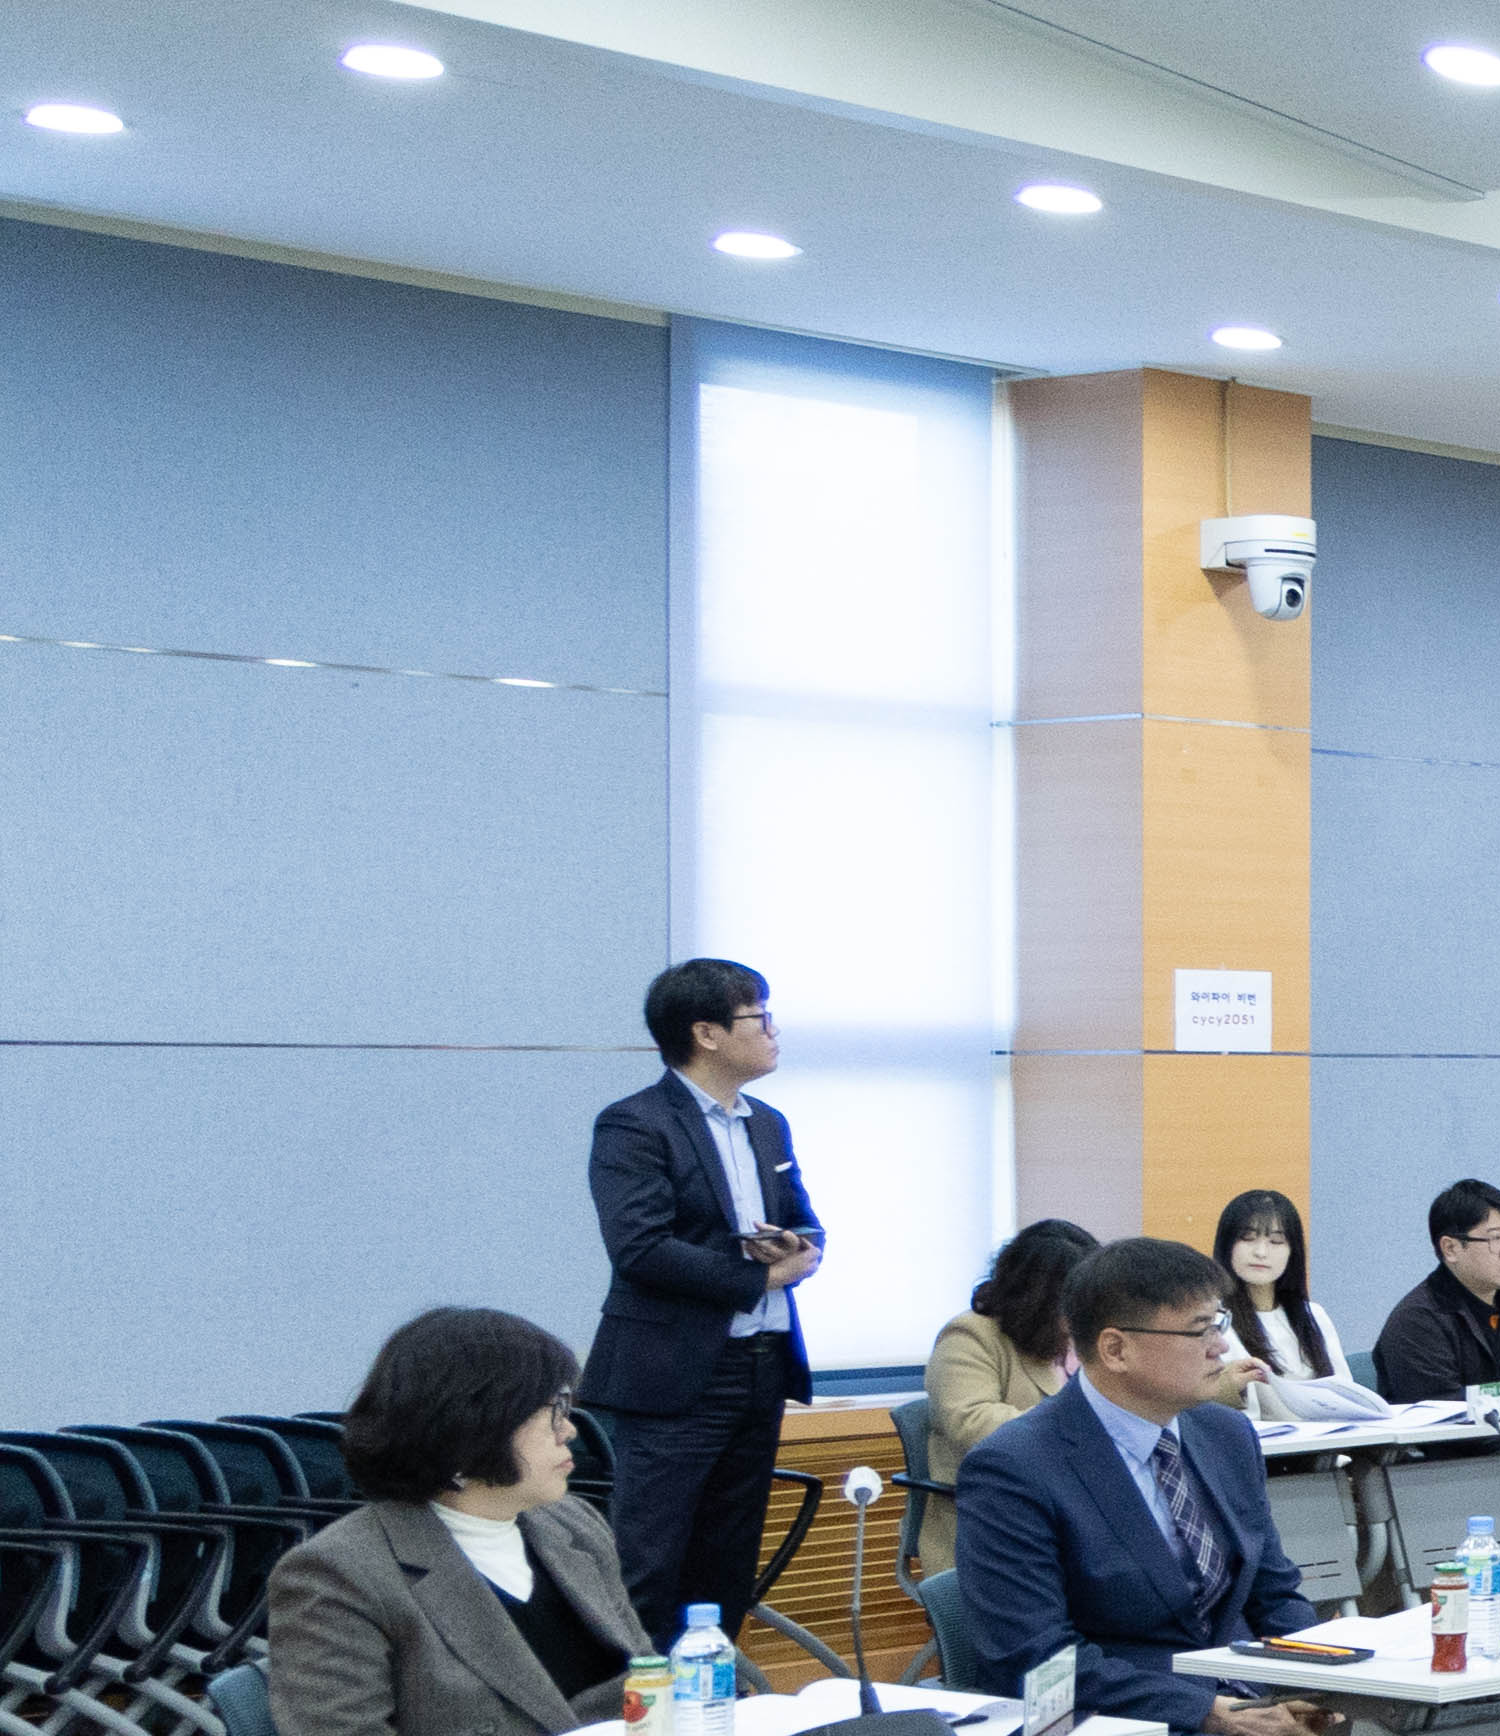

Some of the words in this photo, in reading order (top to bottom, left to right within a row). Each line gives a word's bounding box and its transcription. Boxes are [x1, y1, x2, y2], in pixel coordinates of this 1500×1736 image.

[1190, 991, 1231, 1003] 와이파이
[1237, 992, 1256, 1006] 비번
[1191, 1014, 1255, 1026] cycy2051
